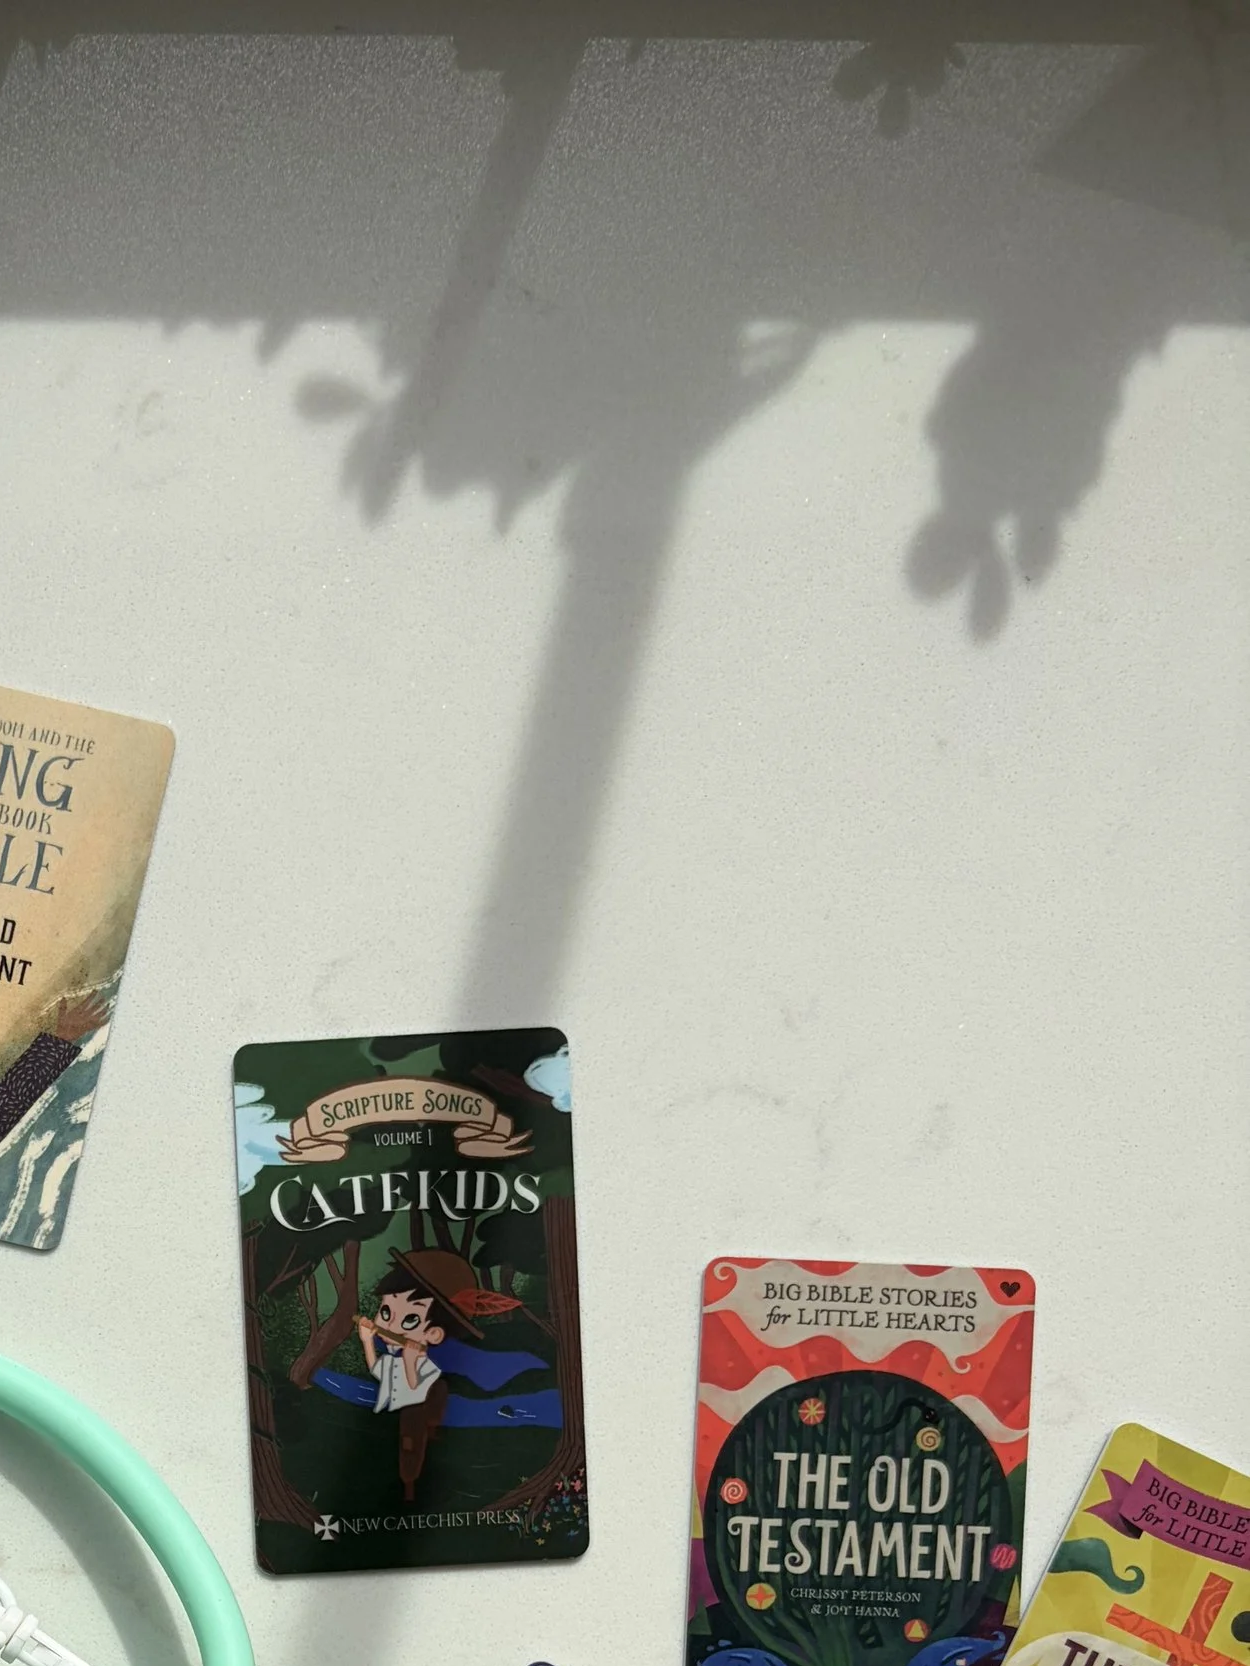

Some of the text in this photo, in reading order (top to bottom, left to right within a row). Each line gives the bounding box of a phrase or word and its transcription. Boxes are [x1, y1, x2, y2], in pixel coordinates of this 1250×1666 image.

[28, 728, 61, 747] AND
[65, 734, 95, 755] THE
[320, 1089, 482, 1128] SCRIPTURE SONGS
[374, 1131, 423, 1147] VOLUME
[270, 1170, 541, 1232] CATEKIDS
[763, 1283, 978, 1308] BIG BIBLE STORIES
[761, 1306, 976, 1333] for LITTLE HEARTS
[774, 1452, 950, 1514] THE OLD
[1146, 1477, 1250, 1534] BIG BIBLE
[341, 1510, 520, 1535] NEW CATECHIST PRESS
[1132, 1504, 1247, 1558] for LITTLE
[727, 1516, 990, 1581] TESTAMENT
[791, 1588, 921, 1602] CHRISSY PETERSON
[811, 1604, 900, 1618] & JOY HANNA
